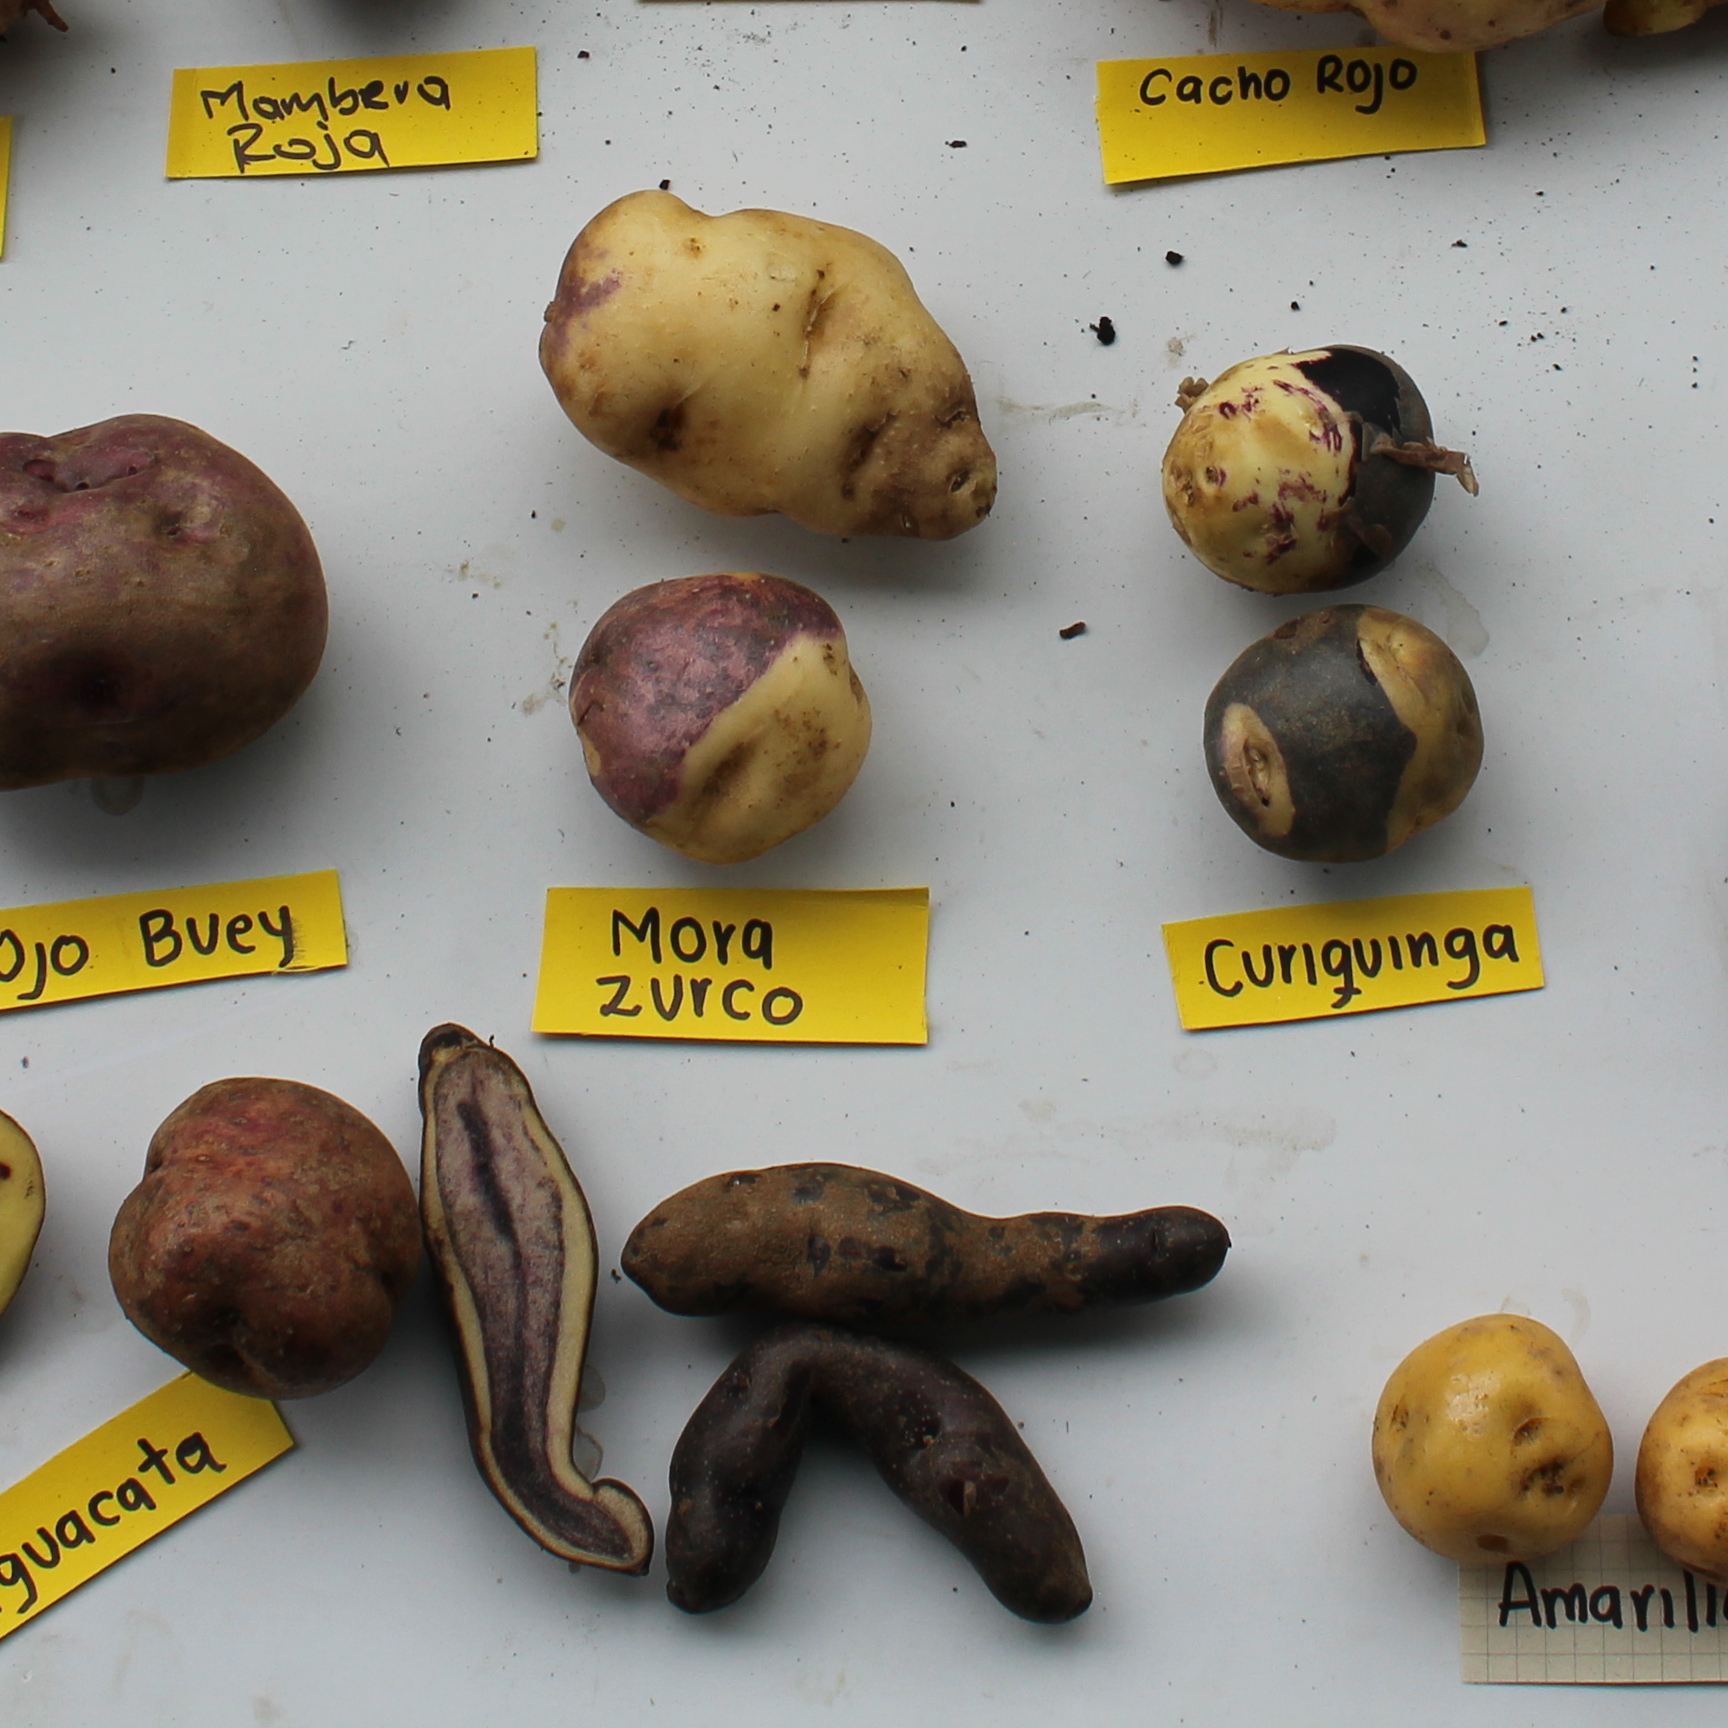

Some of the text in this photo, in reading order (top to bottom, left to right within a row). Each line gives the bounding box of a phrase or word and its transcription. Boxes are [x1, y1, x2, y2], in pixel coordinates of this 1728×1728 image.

[1139, 66, 1271, 106] Cacho
[227, 122, 390, 173] Roja
[138, 905, 294, 968] Buey
[612, 907, 774, 969] Mora
